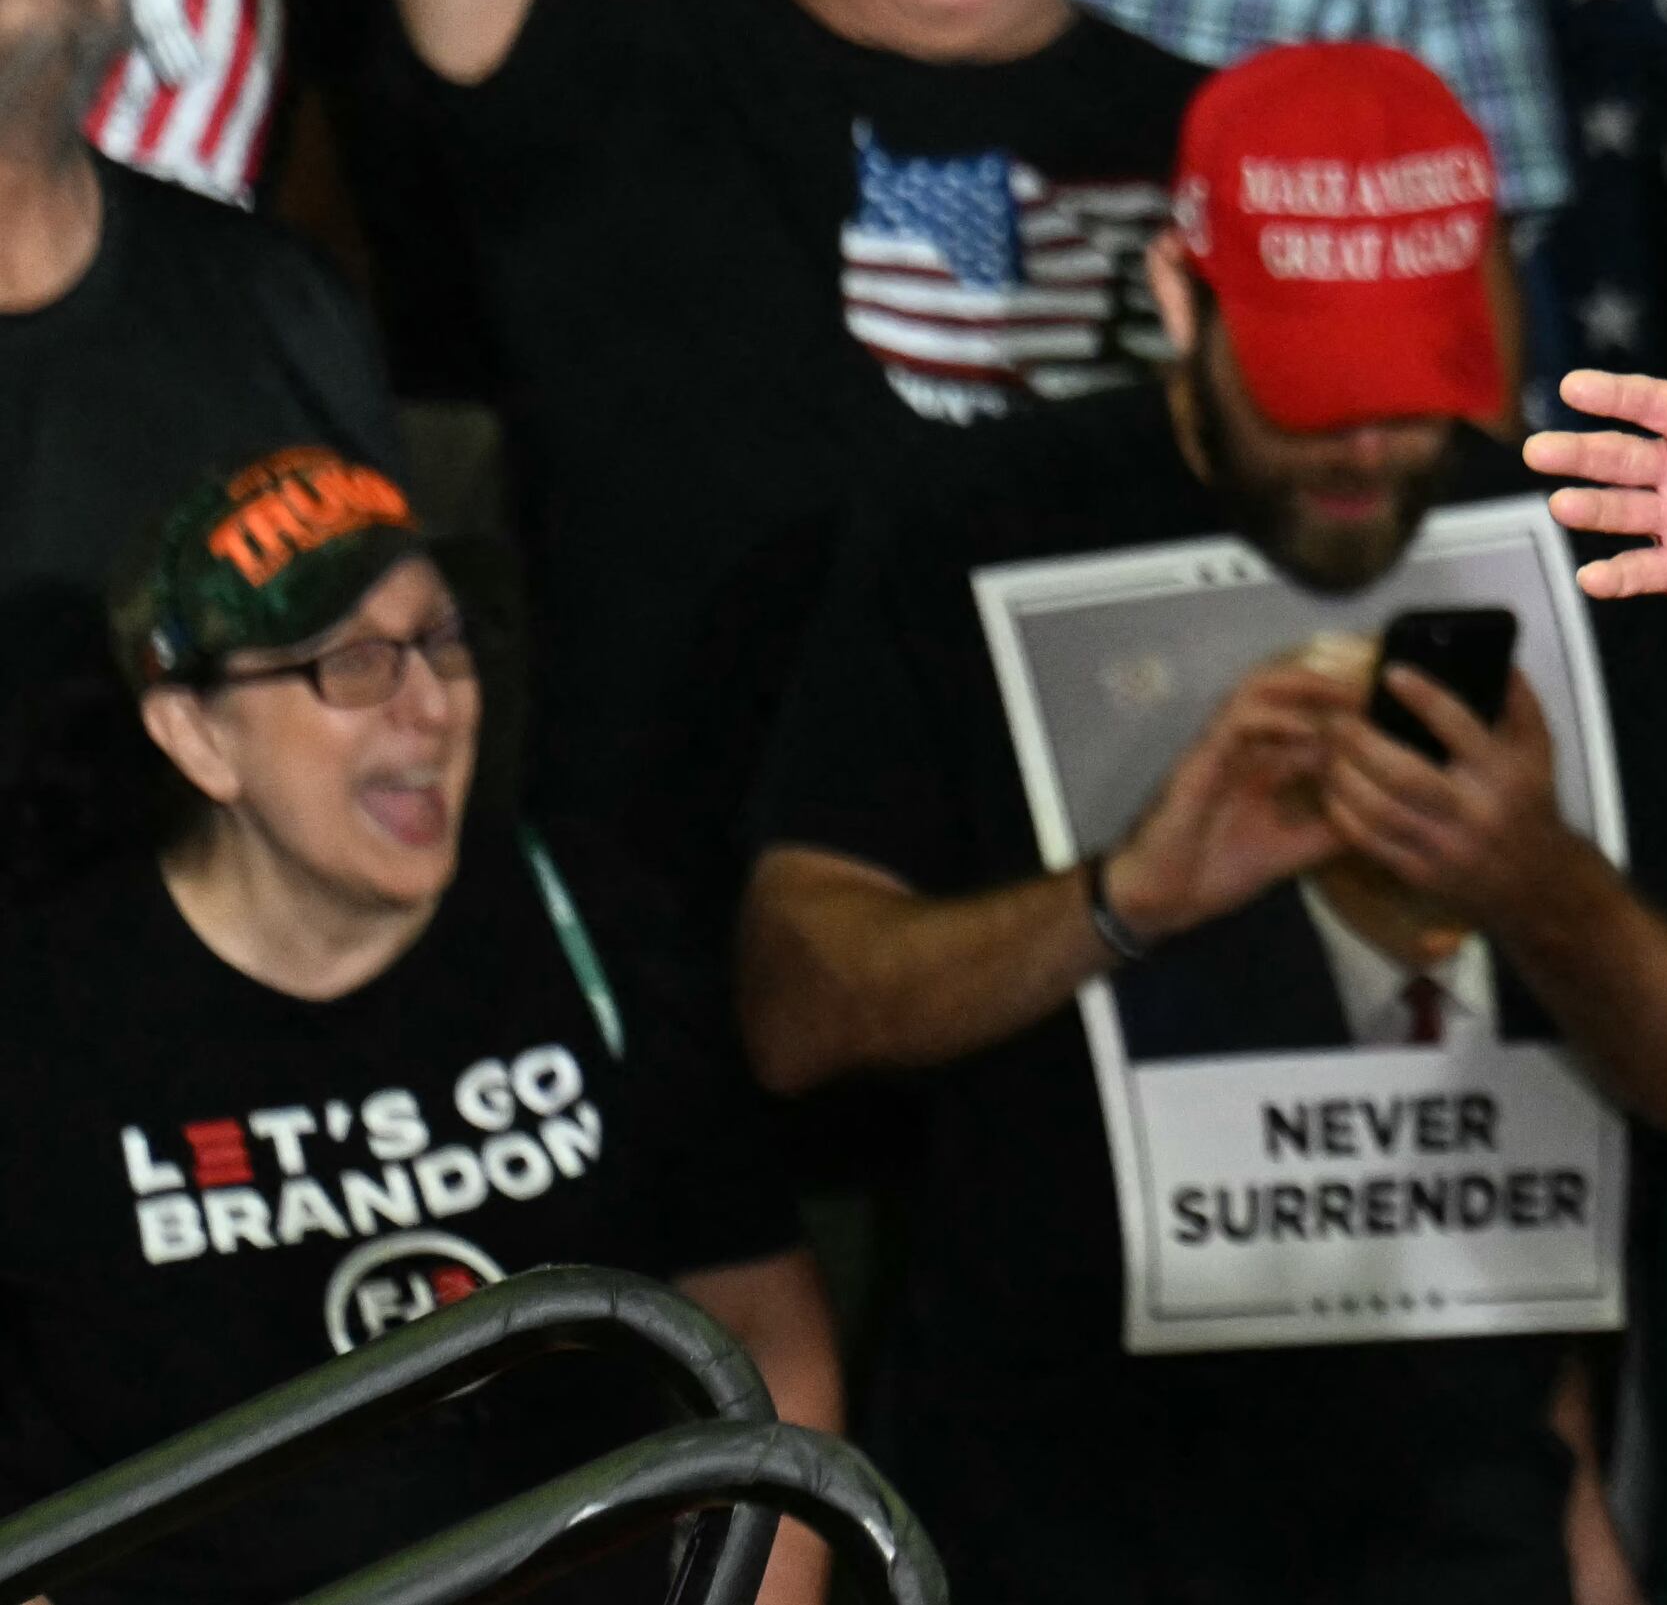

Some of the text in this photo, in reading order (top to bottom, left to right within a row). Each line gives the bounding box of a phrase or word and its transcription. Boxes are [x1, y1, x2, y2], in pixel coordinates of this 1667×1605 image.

[1240, 155, 1348, 218] MAKE
[1353, 146, 1493, 218] AMERICA
[1259, 213, 1479, 281] GREAT AGAIN
[121, 1042, 583, 1196] LET'S GO
[1262, 1089, 1500, 1165] NEVER
[134, 1101, 601, 1266] BRANDON
[1170, 1164, 1592, 1248] SURRENDER
